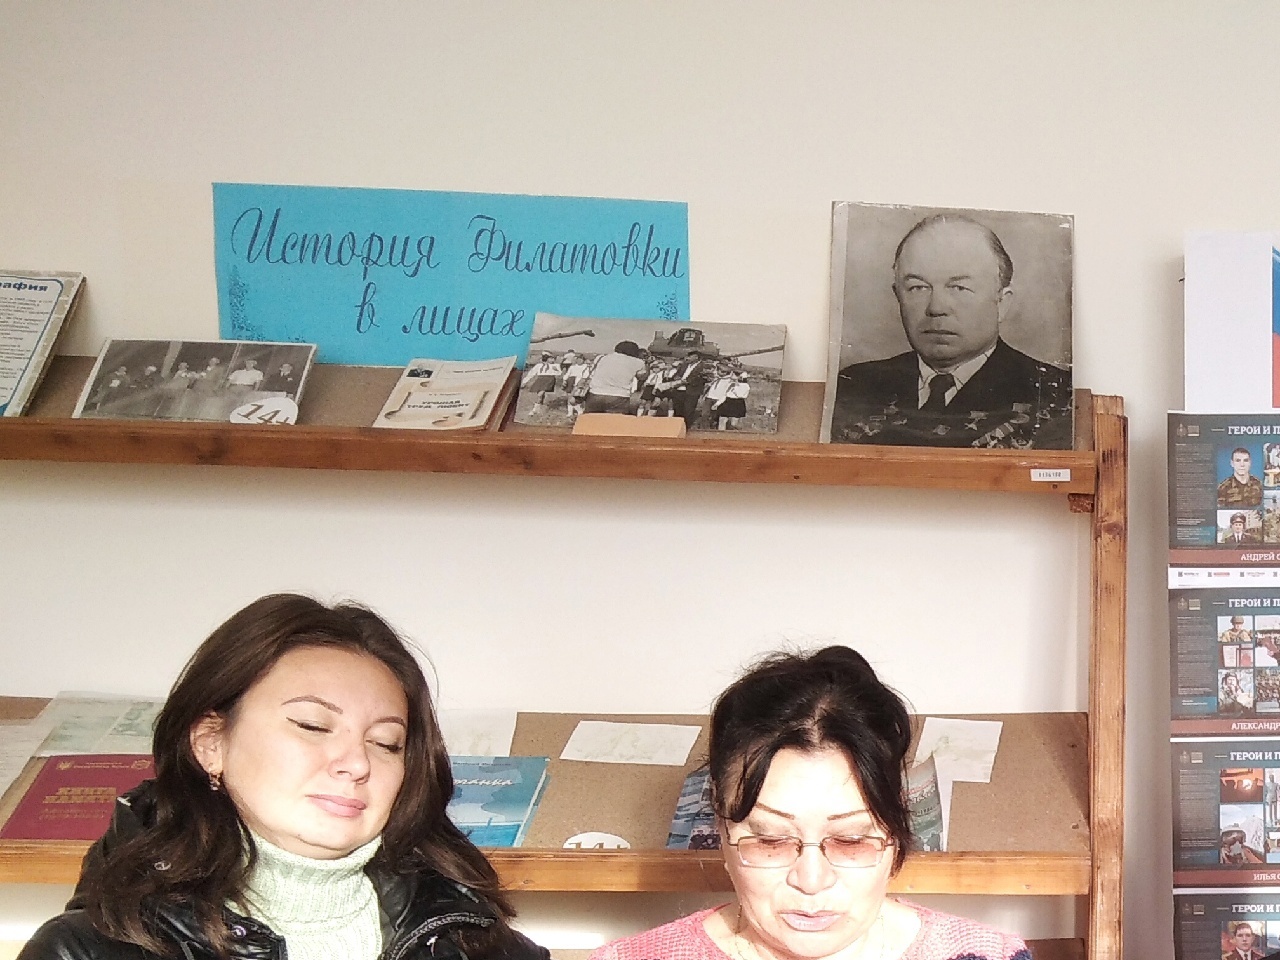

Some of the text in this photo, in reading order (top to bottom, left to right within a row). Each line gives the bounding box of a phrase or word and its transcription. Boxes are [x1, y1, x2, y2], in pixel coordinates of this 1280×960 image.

[231, 207, 684, 280] История Филатовки
[0, 282, 48, 292] афия
[354, 281, 525, 342] в лицах
[1240, 552, 1274, 561] АНДРЕЙ
[1228, 599, 1260, 608] ГЕРОИ
[1263, 598, 1271, 607] И
[1231, 721, 1280, 730] АЛЕКСАНДР
[1230, 751, 1262, 761] ГЕРОИ
[1264, 751, 1272, 760] И
[1253, 873, 1276, 881] ИЛЬЯ
[1231, 904, 1264, 913] ГЕРОИ
[1266, 904, 1274, 913] И
